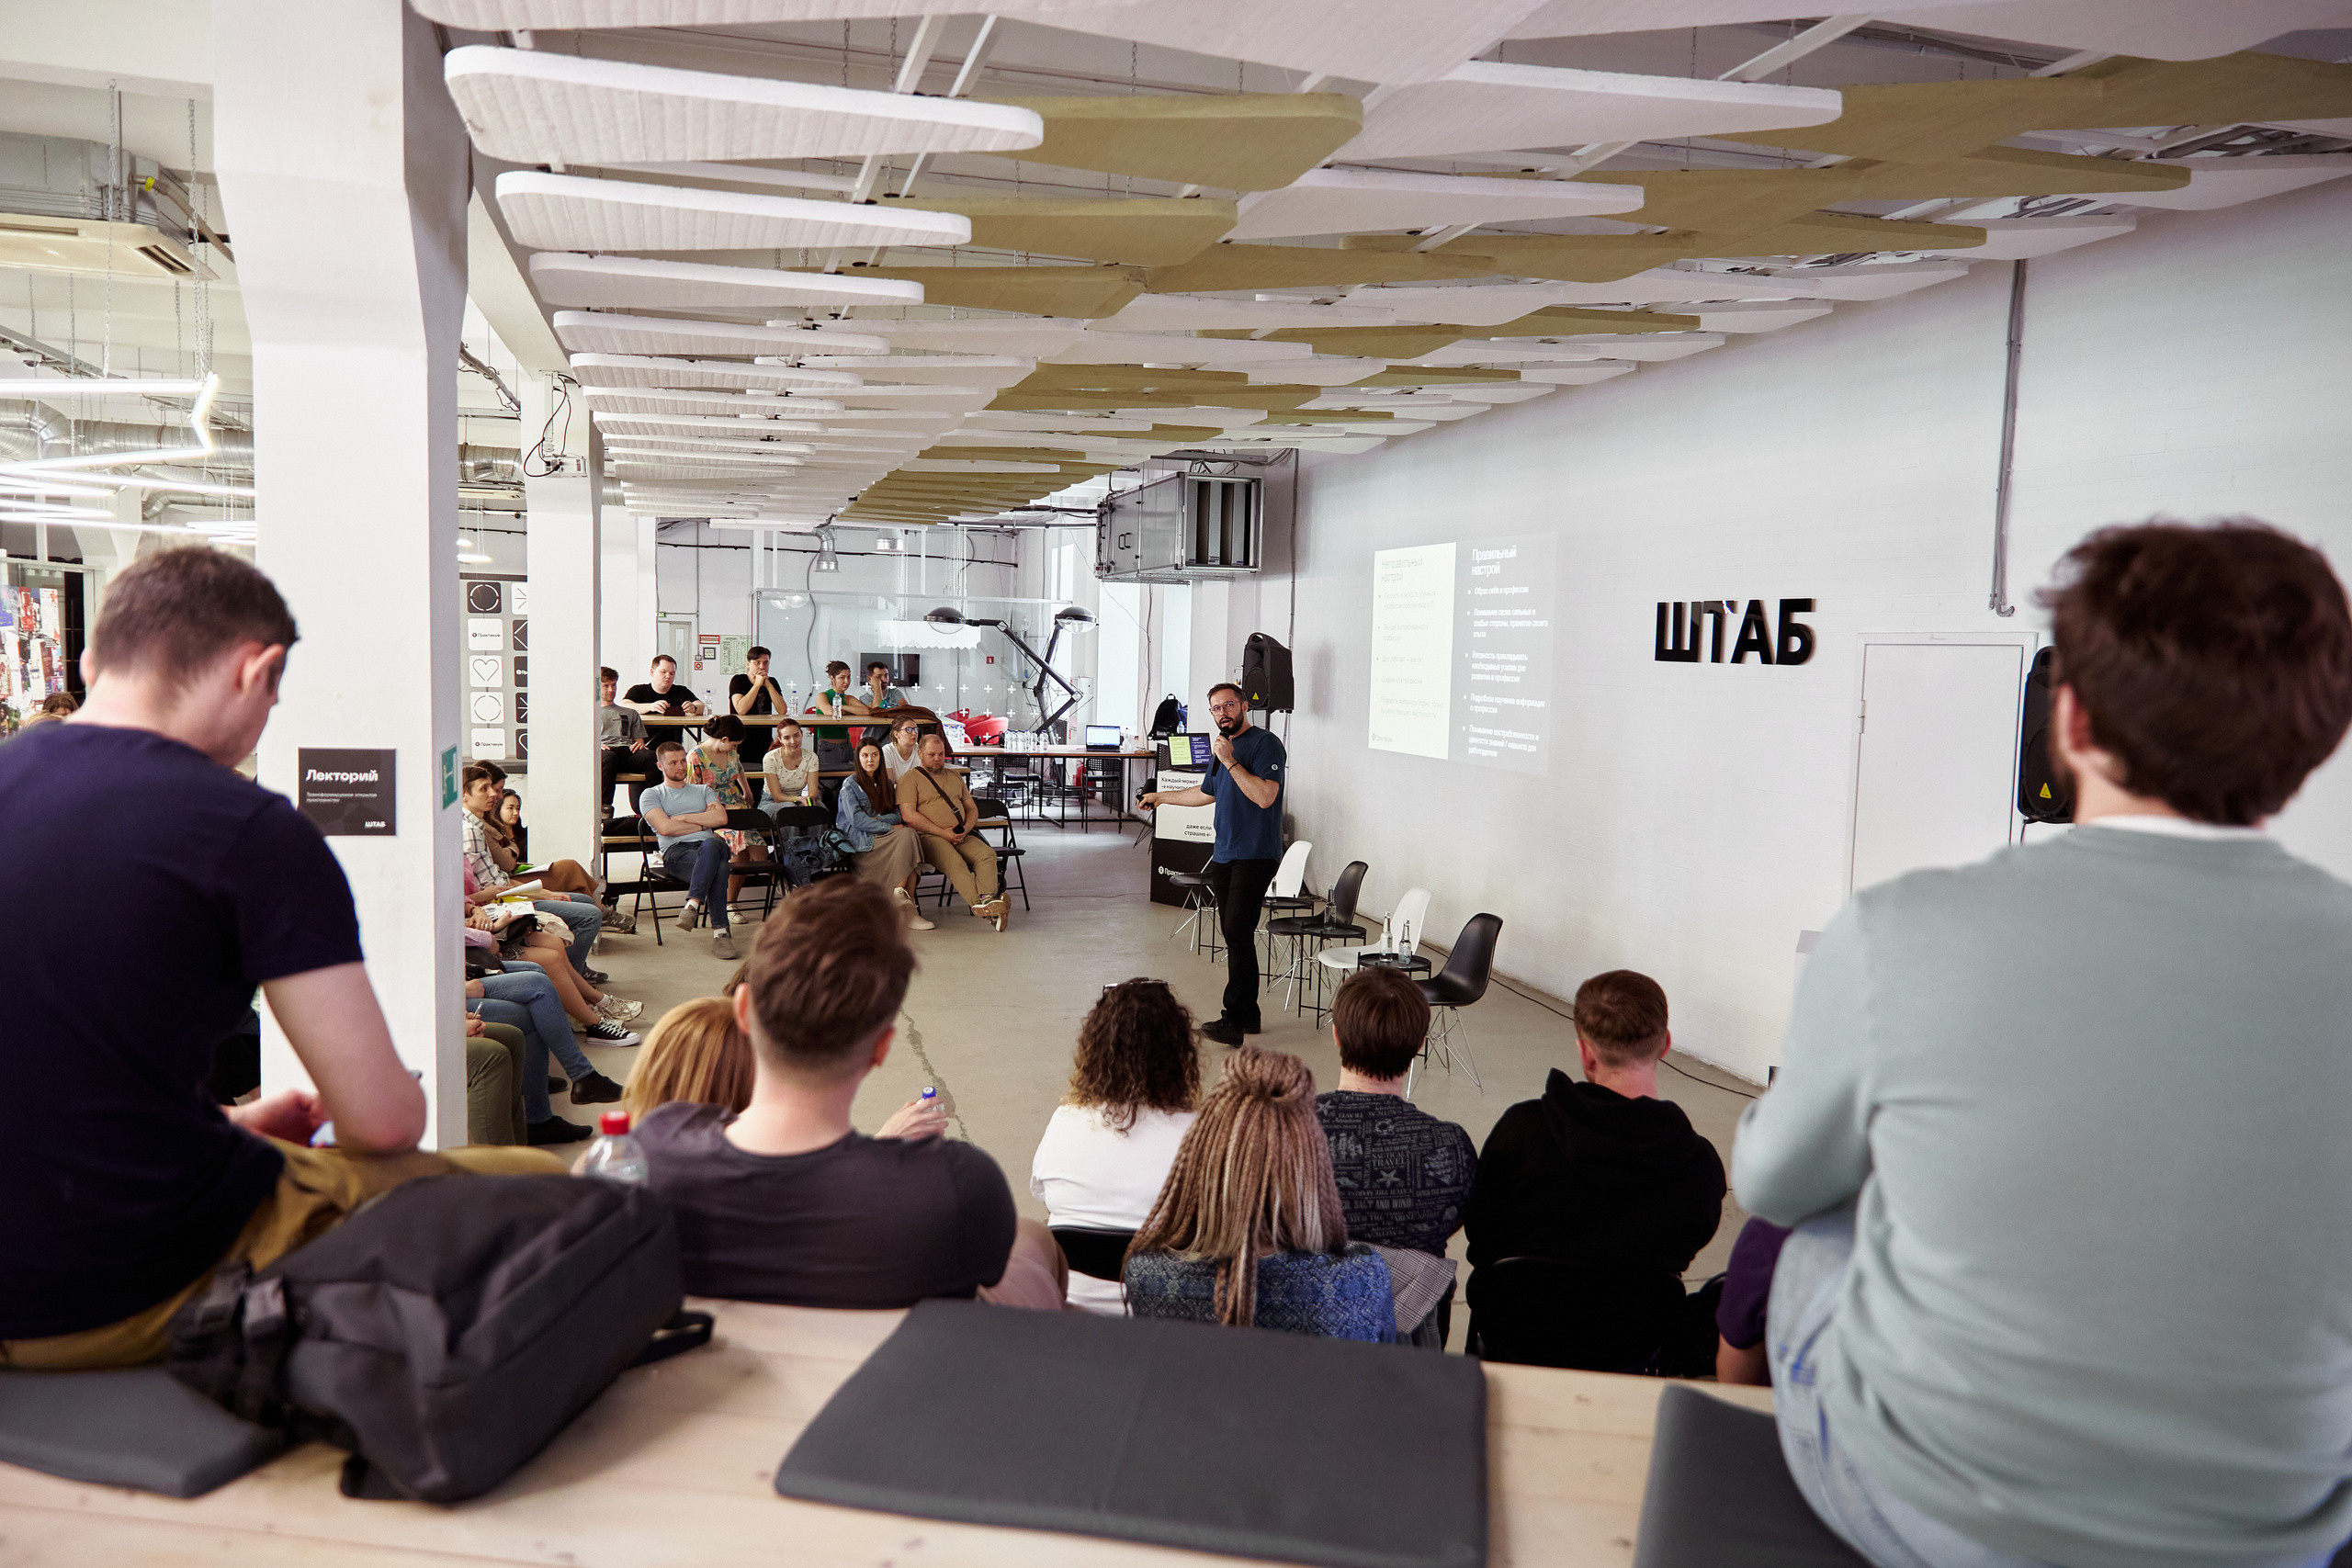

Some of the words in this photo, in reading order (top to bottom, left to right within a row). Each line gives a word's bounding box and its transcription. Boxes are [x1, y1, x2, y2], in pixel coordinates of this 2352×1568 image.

[1472, 545, 1517, 563] Правильный
[1382, 556, 1423, 570] Неправильный
[1471, 561, 1500, 577] настрой
[1503, 585, 1529, 595] профессии
[1655, 598, 1814, 665] ШТАБ
[1495, 674, 1520, 683] профессии
[1474, 705, 1498, 715] профессии
[306, 769, 379, 784] Лекторий
[364, 820, 387, 829] ШТАБ
[1372, 1151, 1404, 1159] NAUTICAL
[1372, 1157, 1405, 1168] TRAVEL
[1353, 1200, 1374, 1209] SALT
[1375, 1200, 1390, 1209] AND
